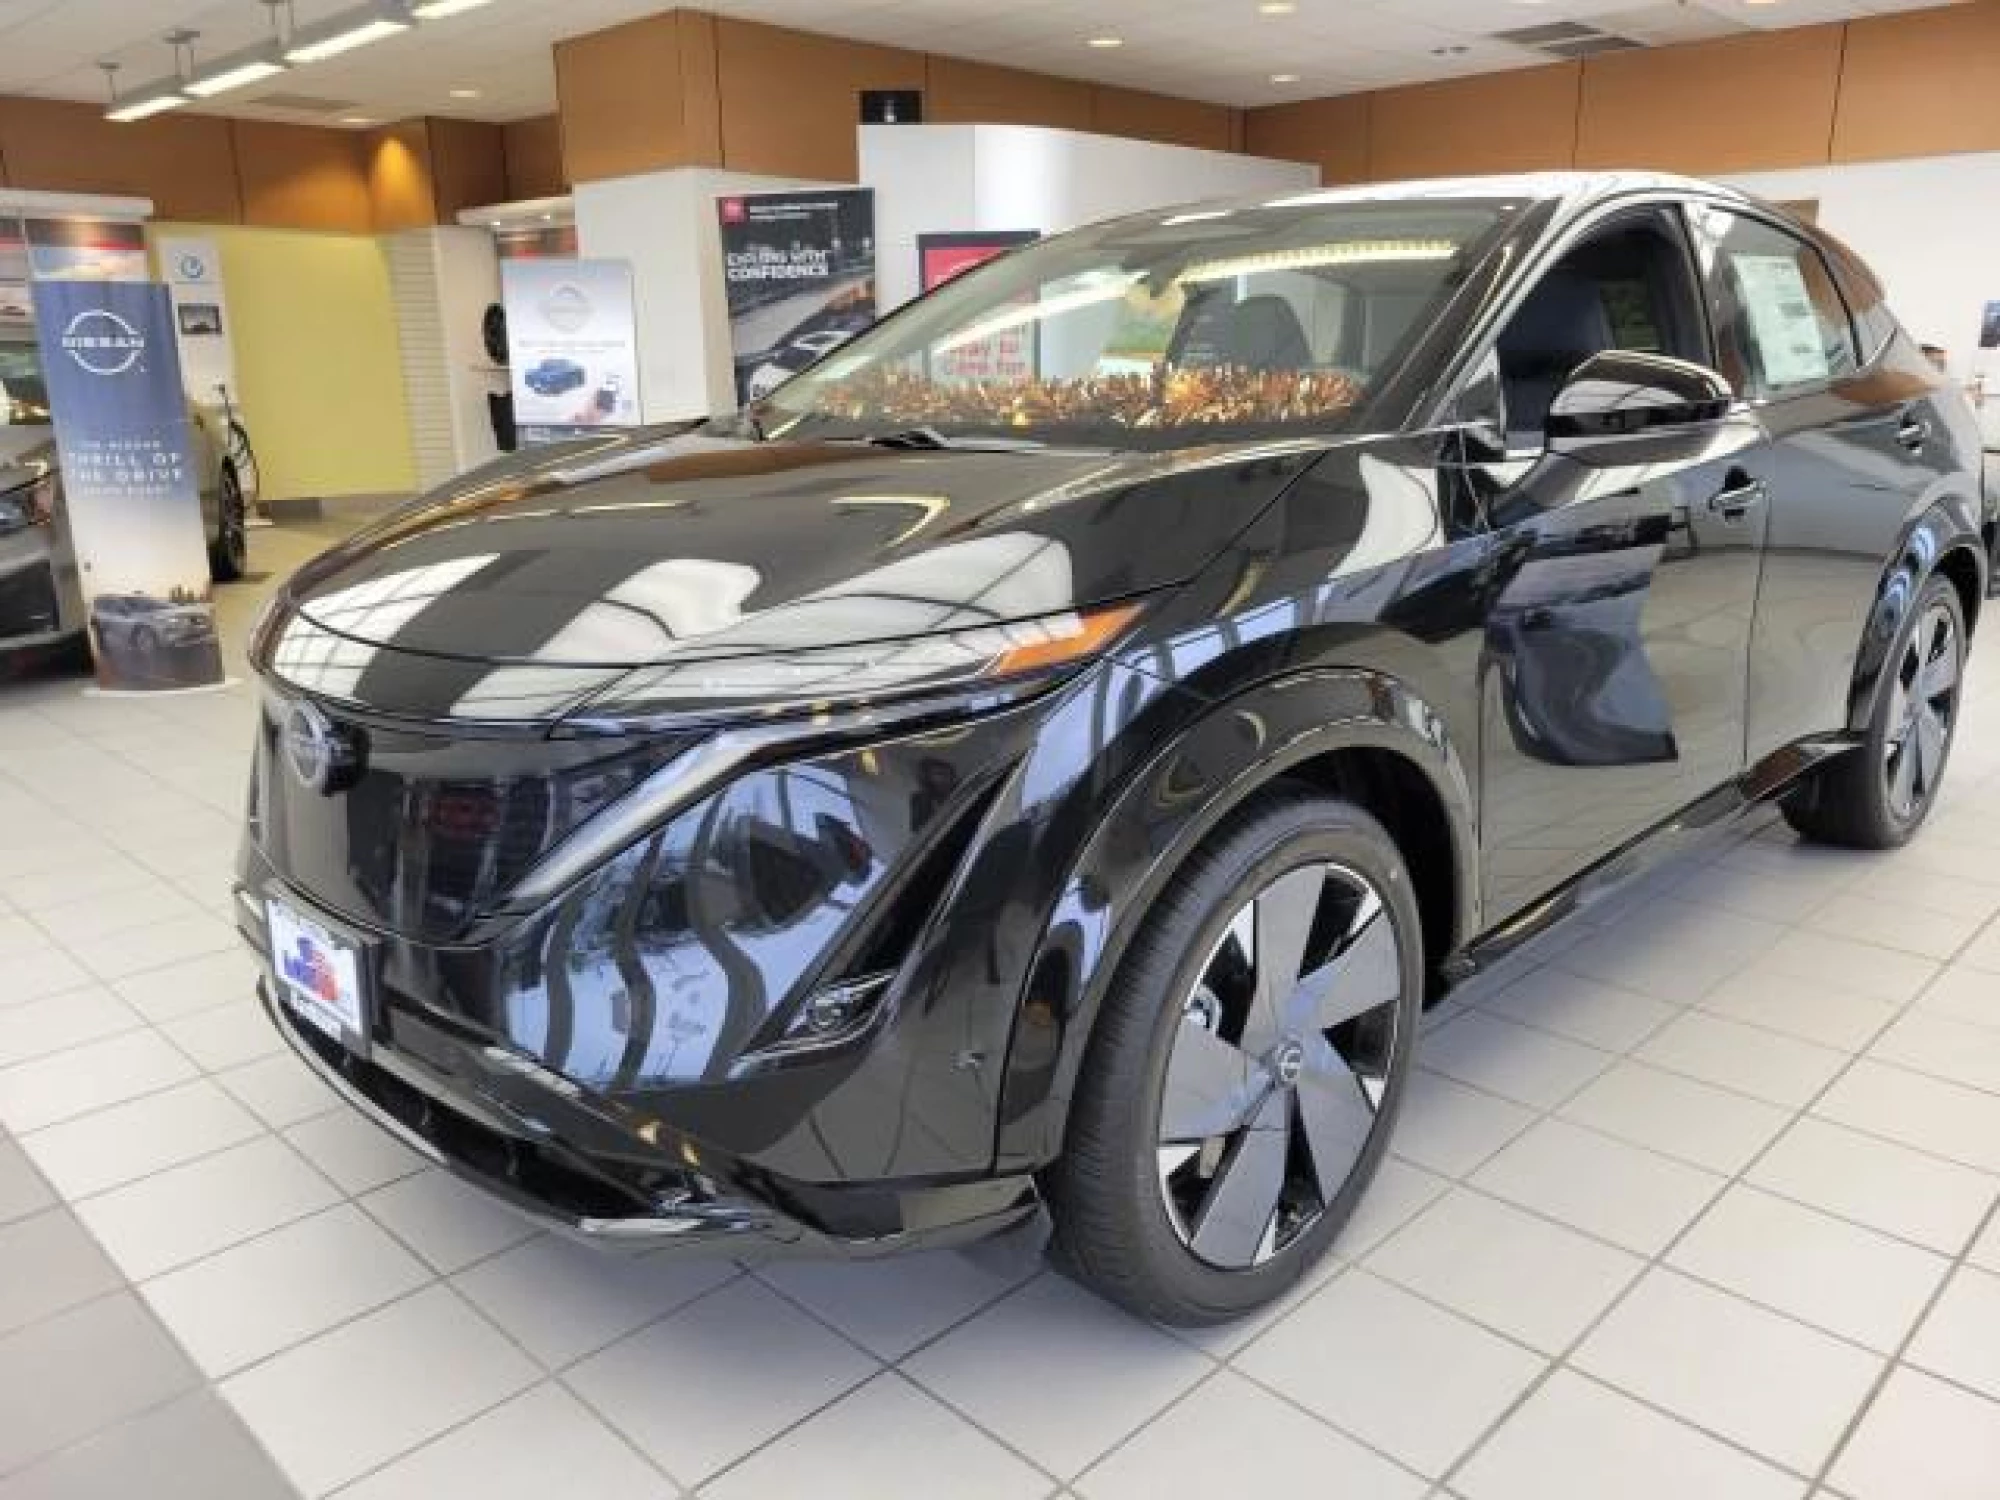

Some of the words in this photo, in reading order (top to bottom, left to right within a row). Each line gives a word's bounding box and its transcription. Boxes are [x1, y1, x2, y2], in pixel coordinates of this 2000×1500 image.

[727, 263, 829, 281] CONFIDENCE
[61, 336, 145, 348] NISSAN
[68, 452, 140, 467] THRILL
[152, 452, 183, 466] OF
[69, 468, 107, 482] THE
[115, 468, 184, 483] DRIVE
